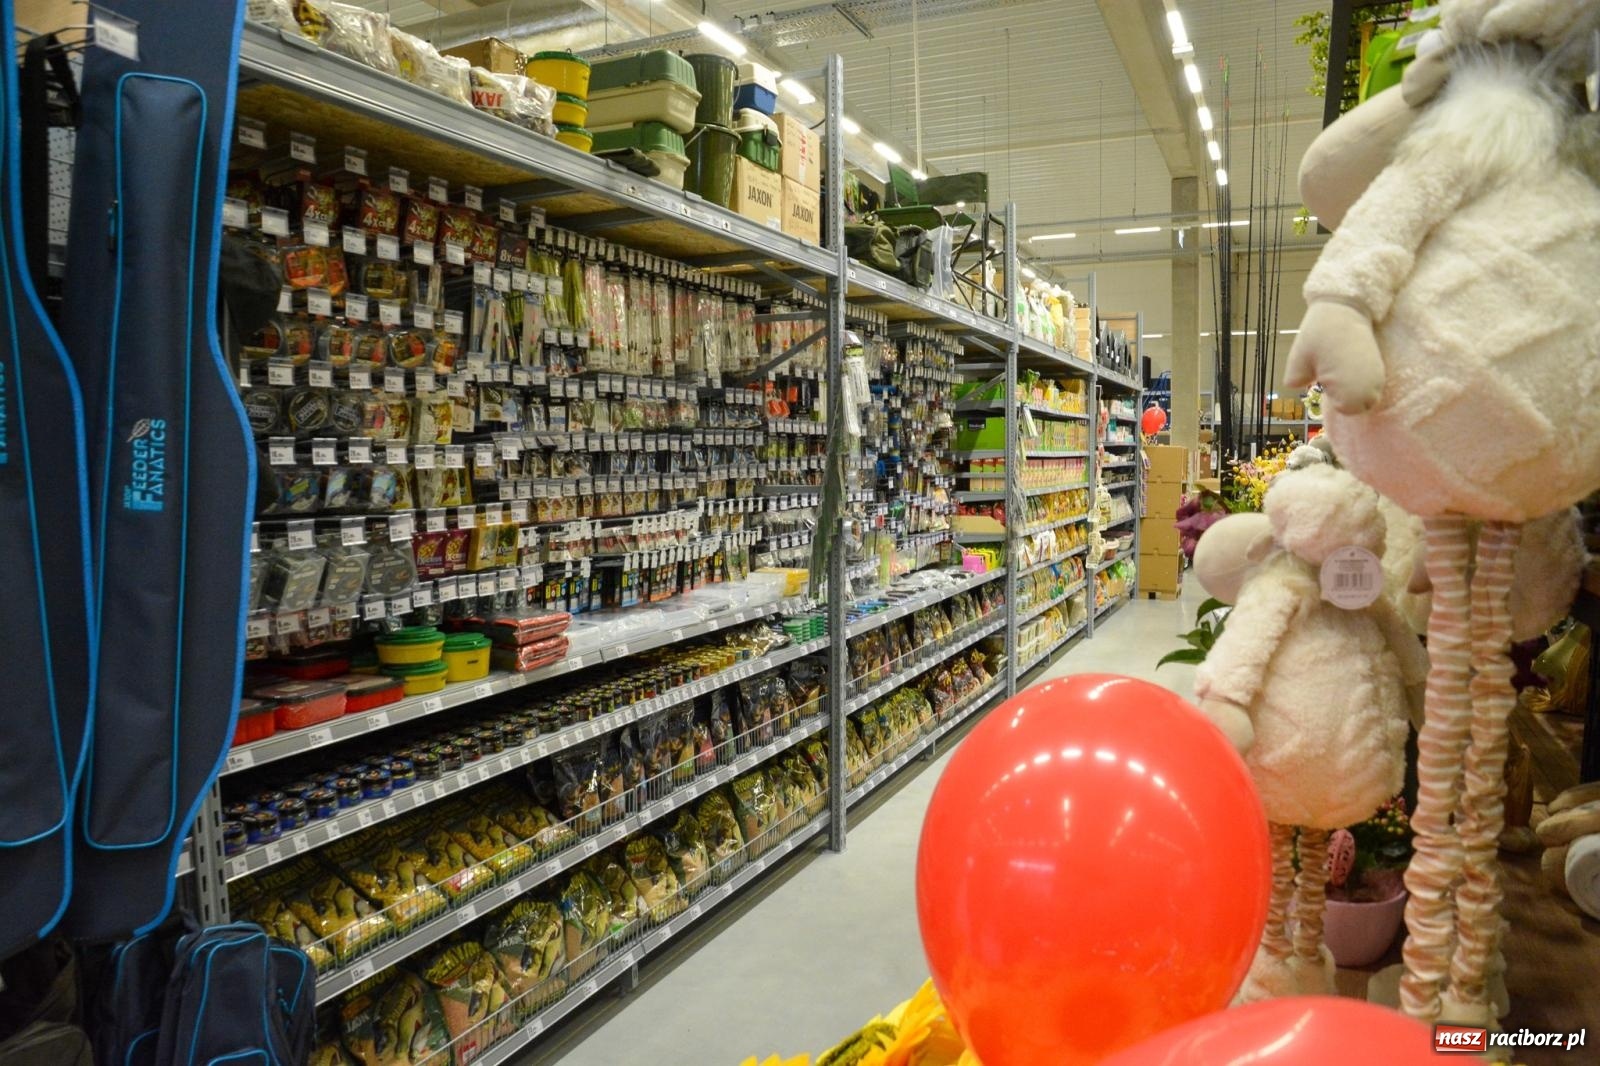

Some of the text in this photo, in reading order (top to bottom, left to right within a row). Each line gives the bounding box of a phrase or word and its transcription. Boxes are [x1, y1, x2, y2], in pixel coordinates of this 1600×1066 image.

[747, 184, 772, 208] JAXON
[792, 203, 814, 224] JAXON
[147, 418, 166, 511] FANATICS
